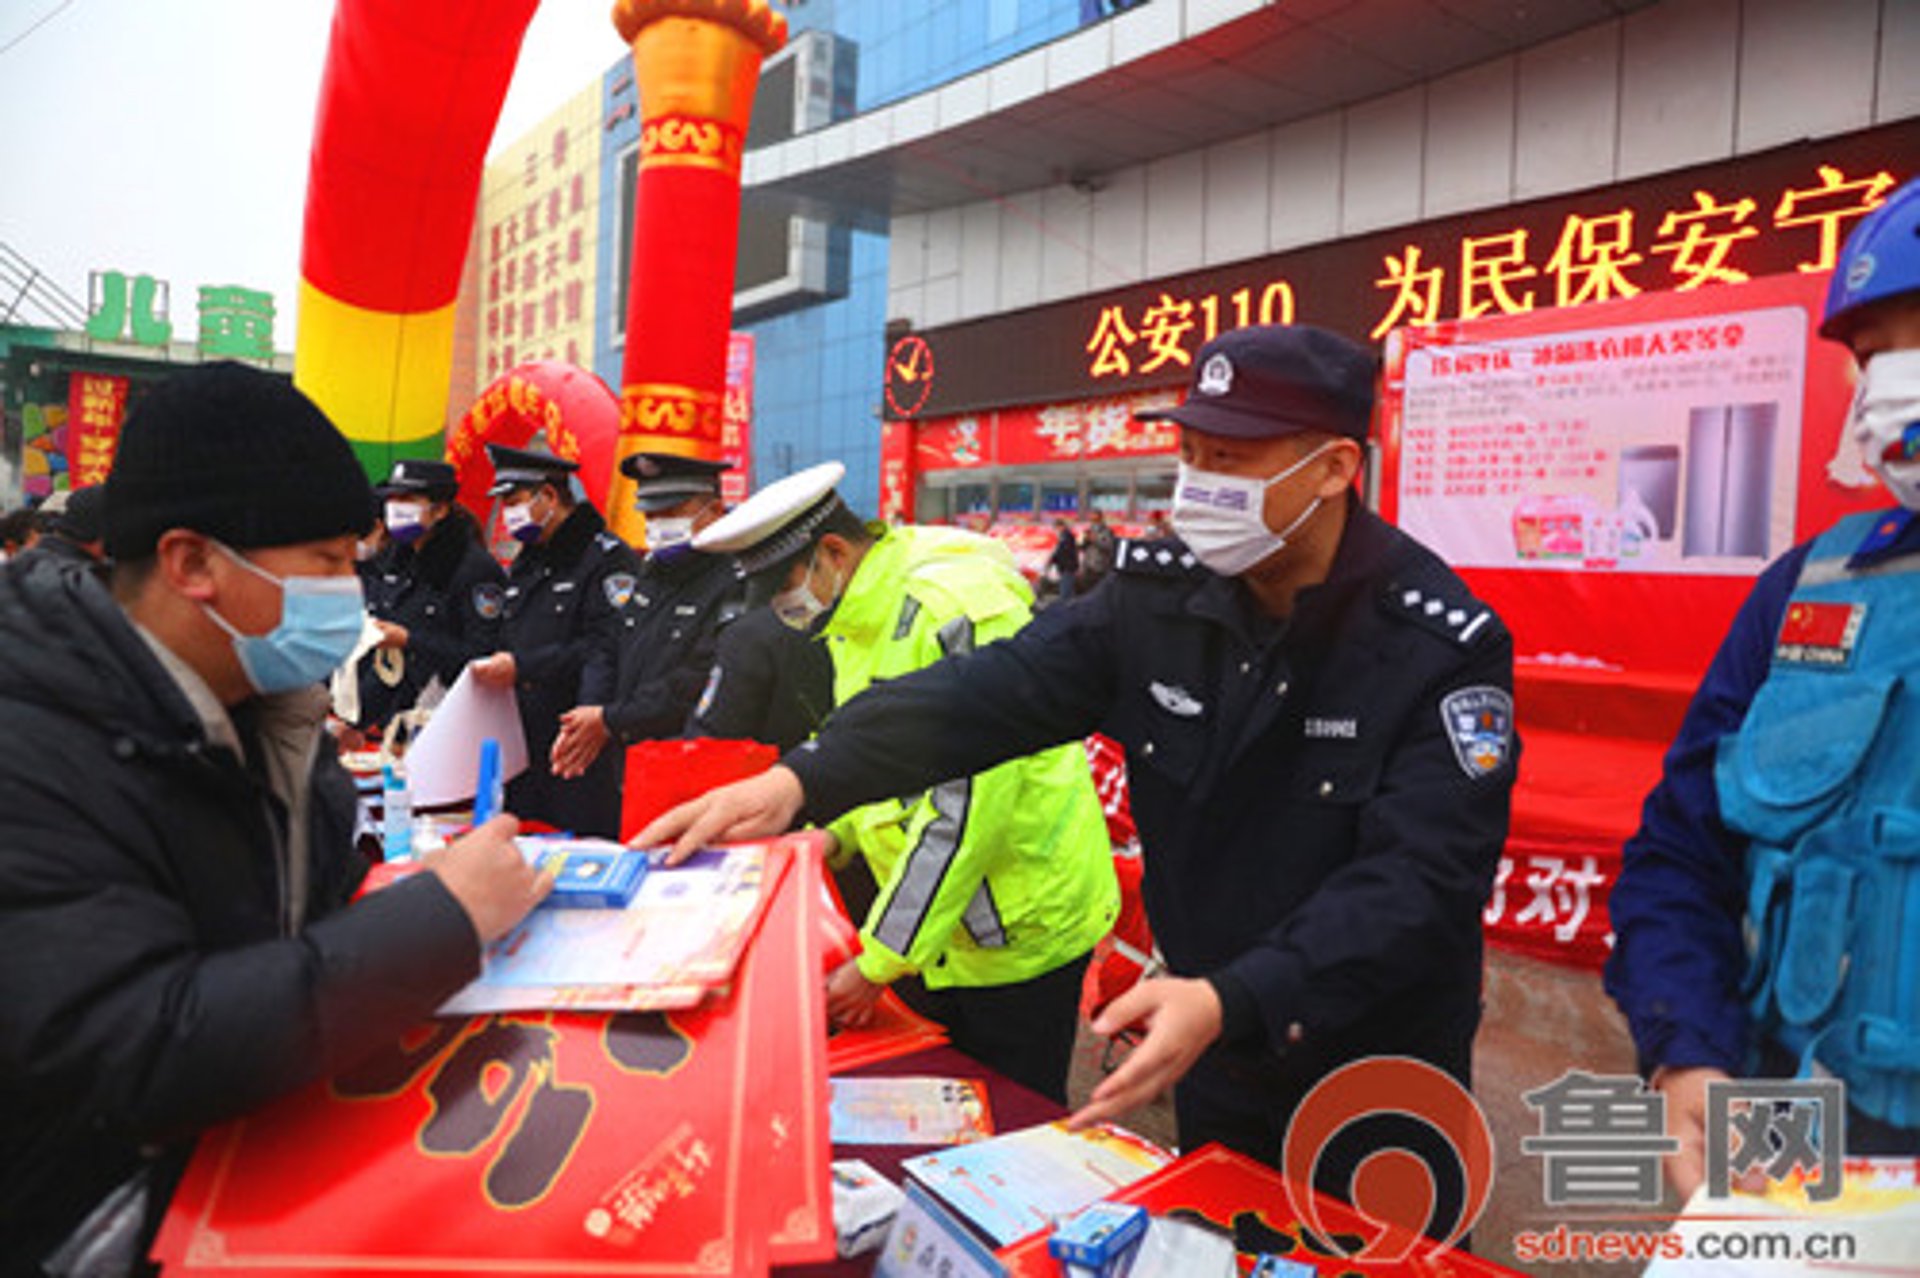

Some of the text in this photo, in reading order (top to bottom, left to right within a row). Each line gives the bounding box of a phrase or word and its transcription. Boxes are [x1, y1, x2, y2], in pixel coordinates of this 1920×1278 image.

[85, 269, 277, 360] 儿童
[1086, 165, 1896, 379] 公安110 为民保安宁
